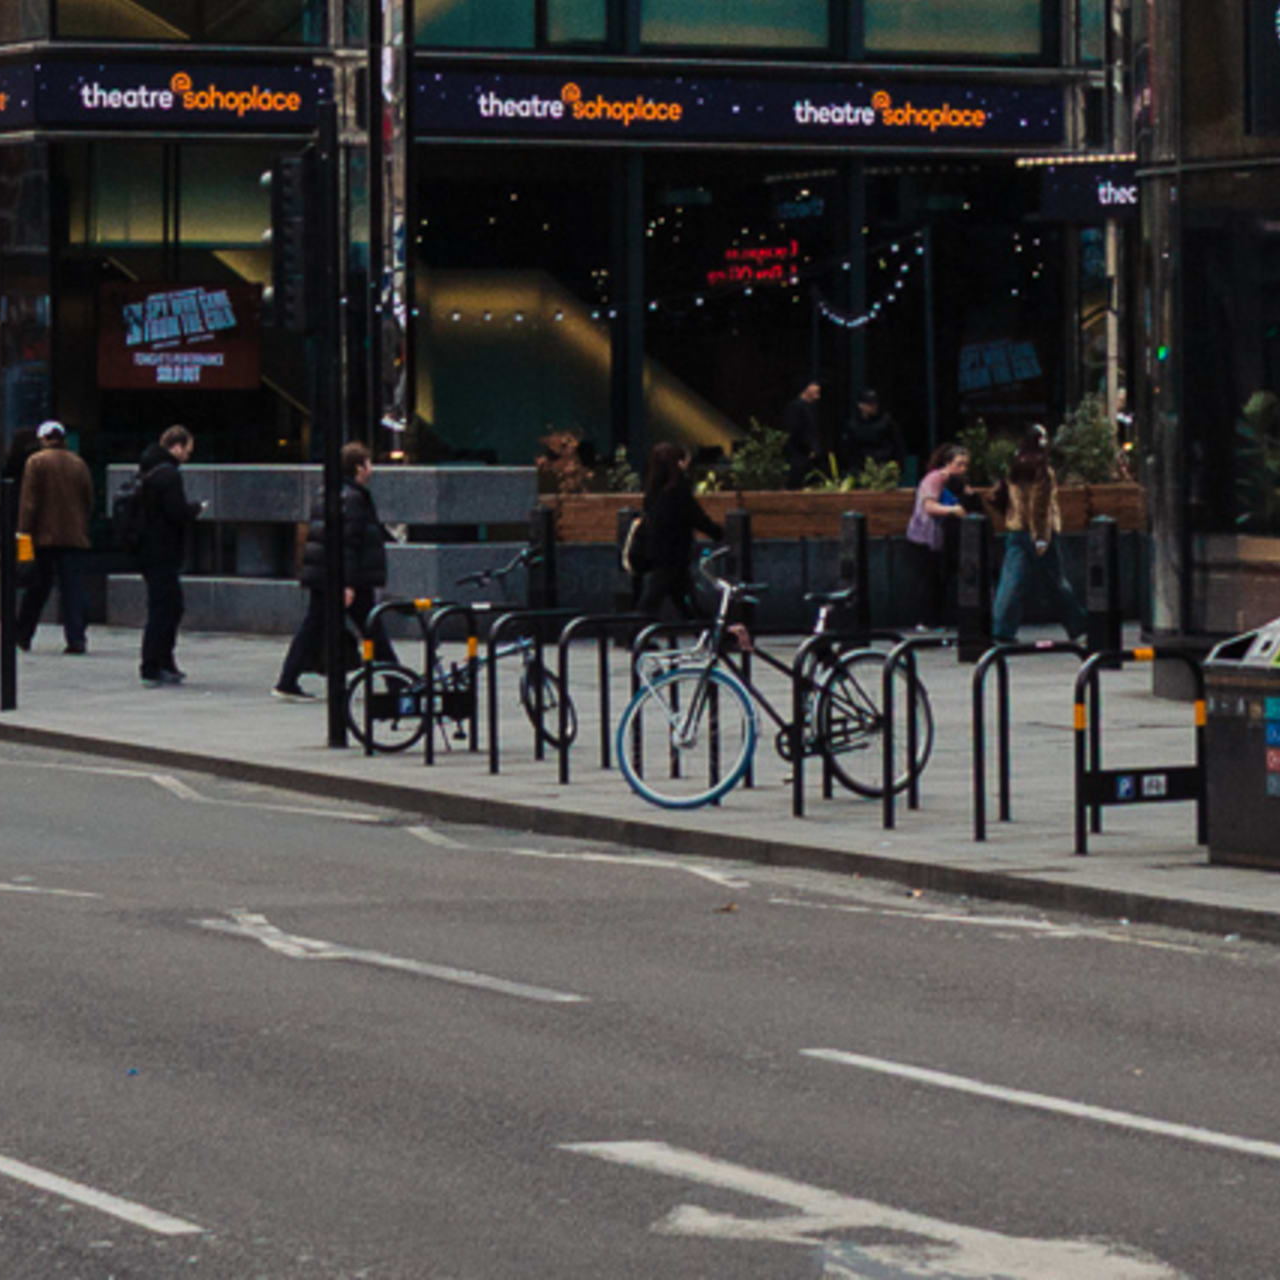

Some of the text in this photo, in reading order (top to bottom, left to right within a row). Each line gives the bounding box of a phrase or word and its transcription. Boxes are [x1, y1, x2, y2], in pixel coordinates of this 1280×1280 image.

[80, 81, 173, 110] theatre
[477, 91, 564, 119] theatre
[794, 99, 876, 126] theatre
